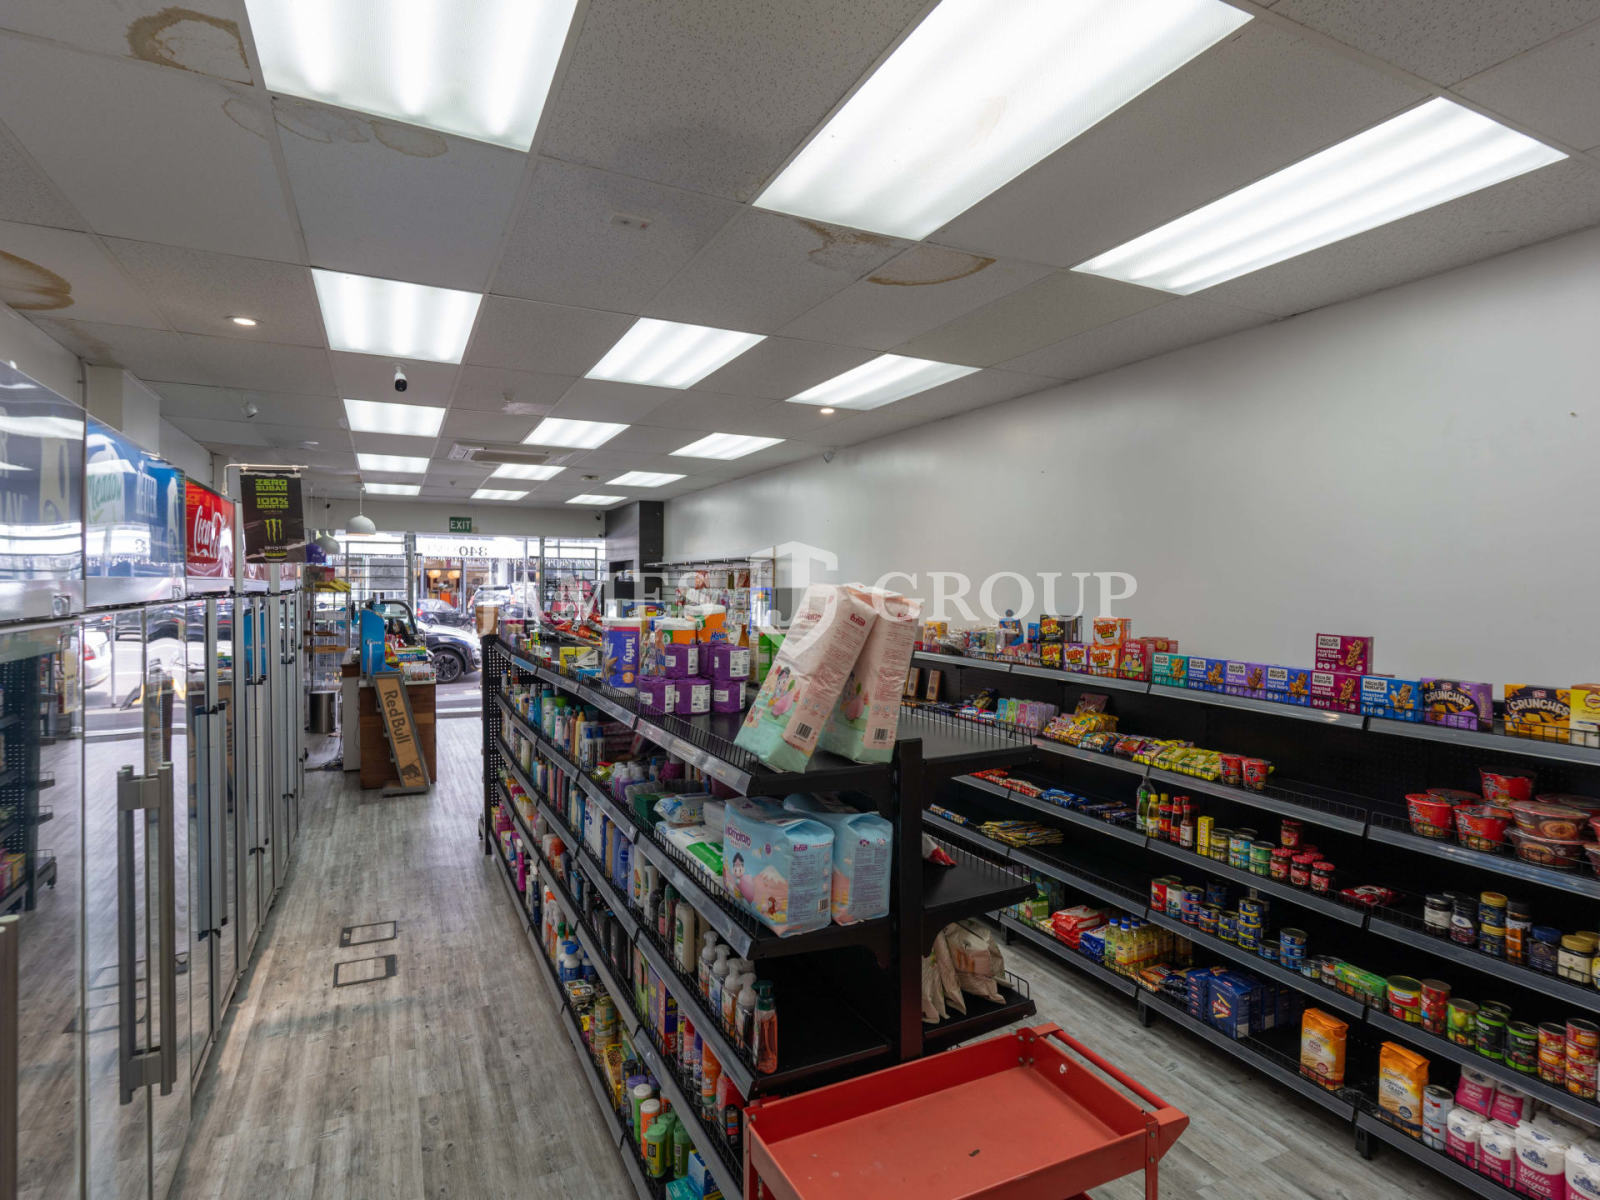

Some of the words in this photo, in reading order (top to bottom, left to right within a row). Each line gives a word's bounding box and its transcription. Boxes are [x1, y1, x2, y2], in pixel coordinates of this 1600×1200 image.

[256, 497, 289, 505] 100%
[450, 520, 471, 530] EXIT
[622, 637, 636, 664] Tuffy
[1424, 690, 1471, 707] CRUNCHES
[1510, 698, 1570, 716] CRUNCHES
[1519, 1165, 1551, 1186] White
